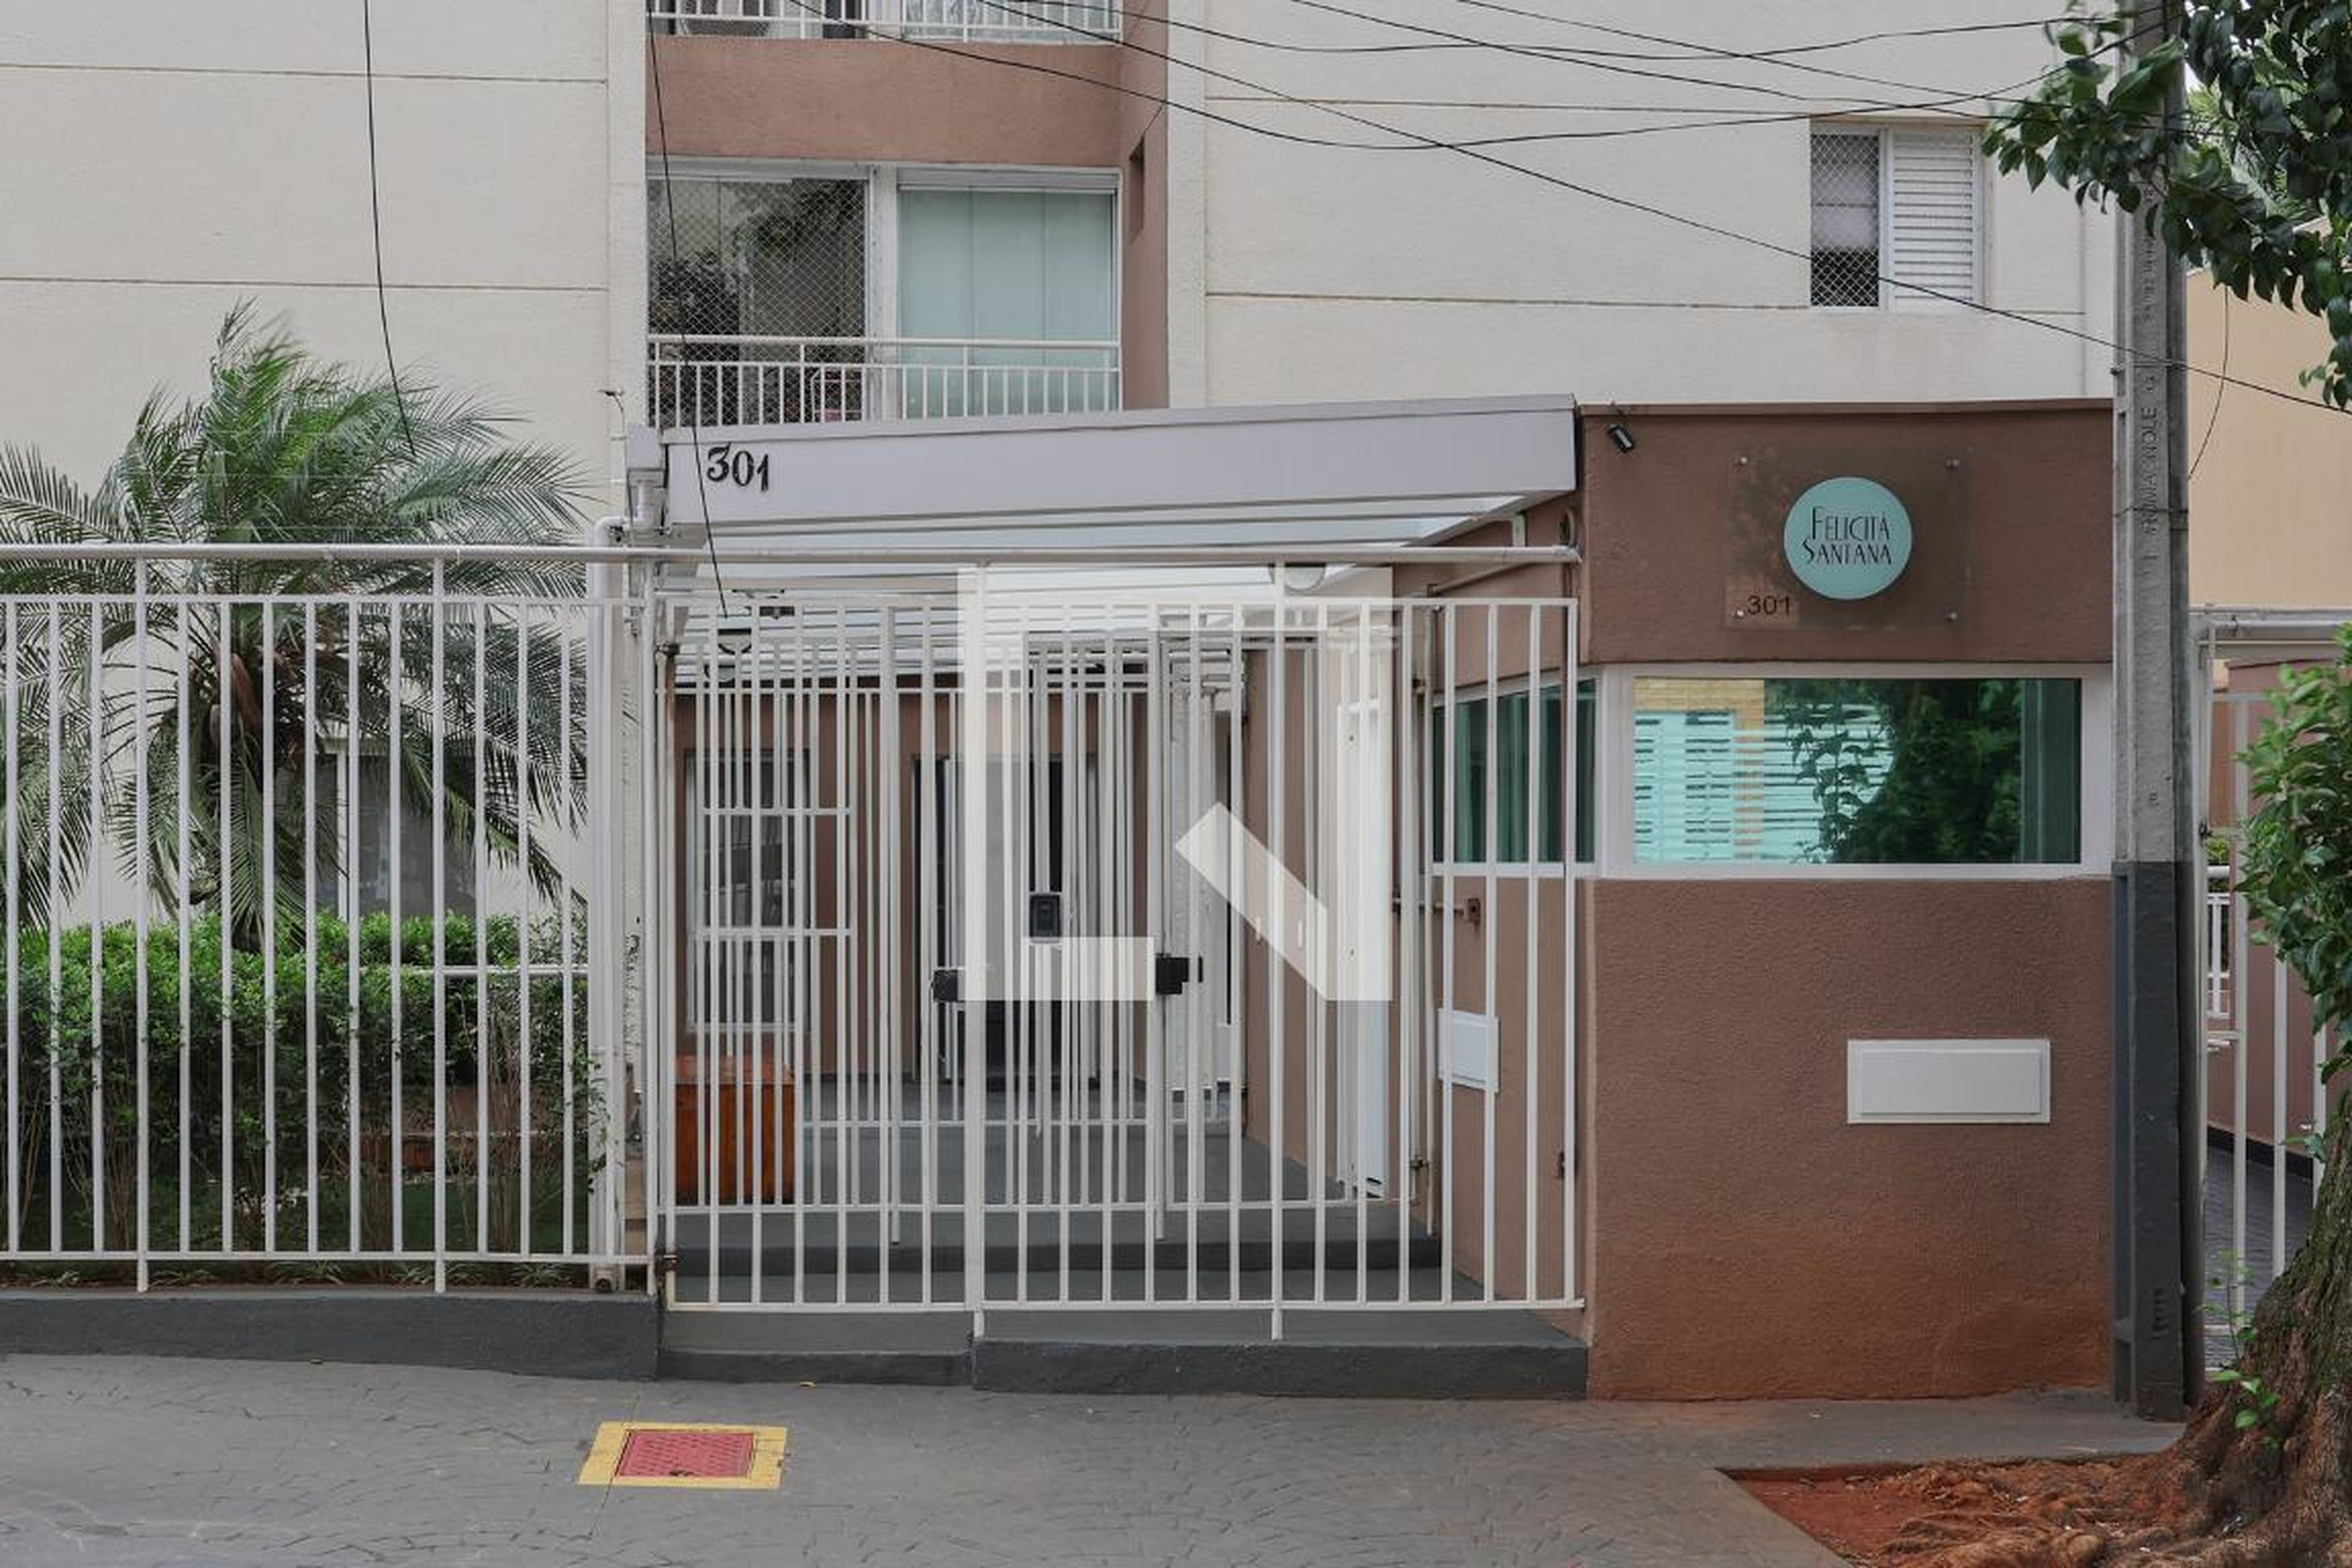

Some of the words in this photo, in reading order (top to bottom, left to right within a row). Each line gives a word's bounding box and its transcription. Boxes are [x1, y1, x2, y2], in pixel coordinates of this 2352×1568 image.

[707, 442, 769, 492] 301
[1801, 537, 1892, 565] SANTANA
[1747, 595, 1789, 616] 301
